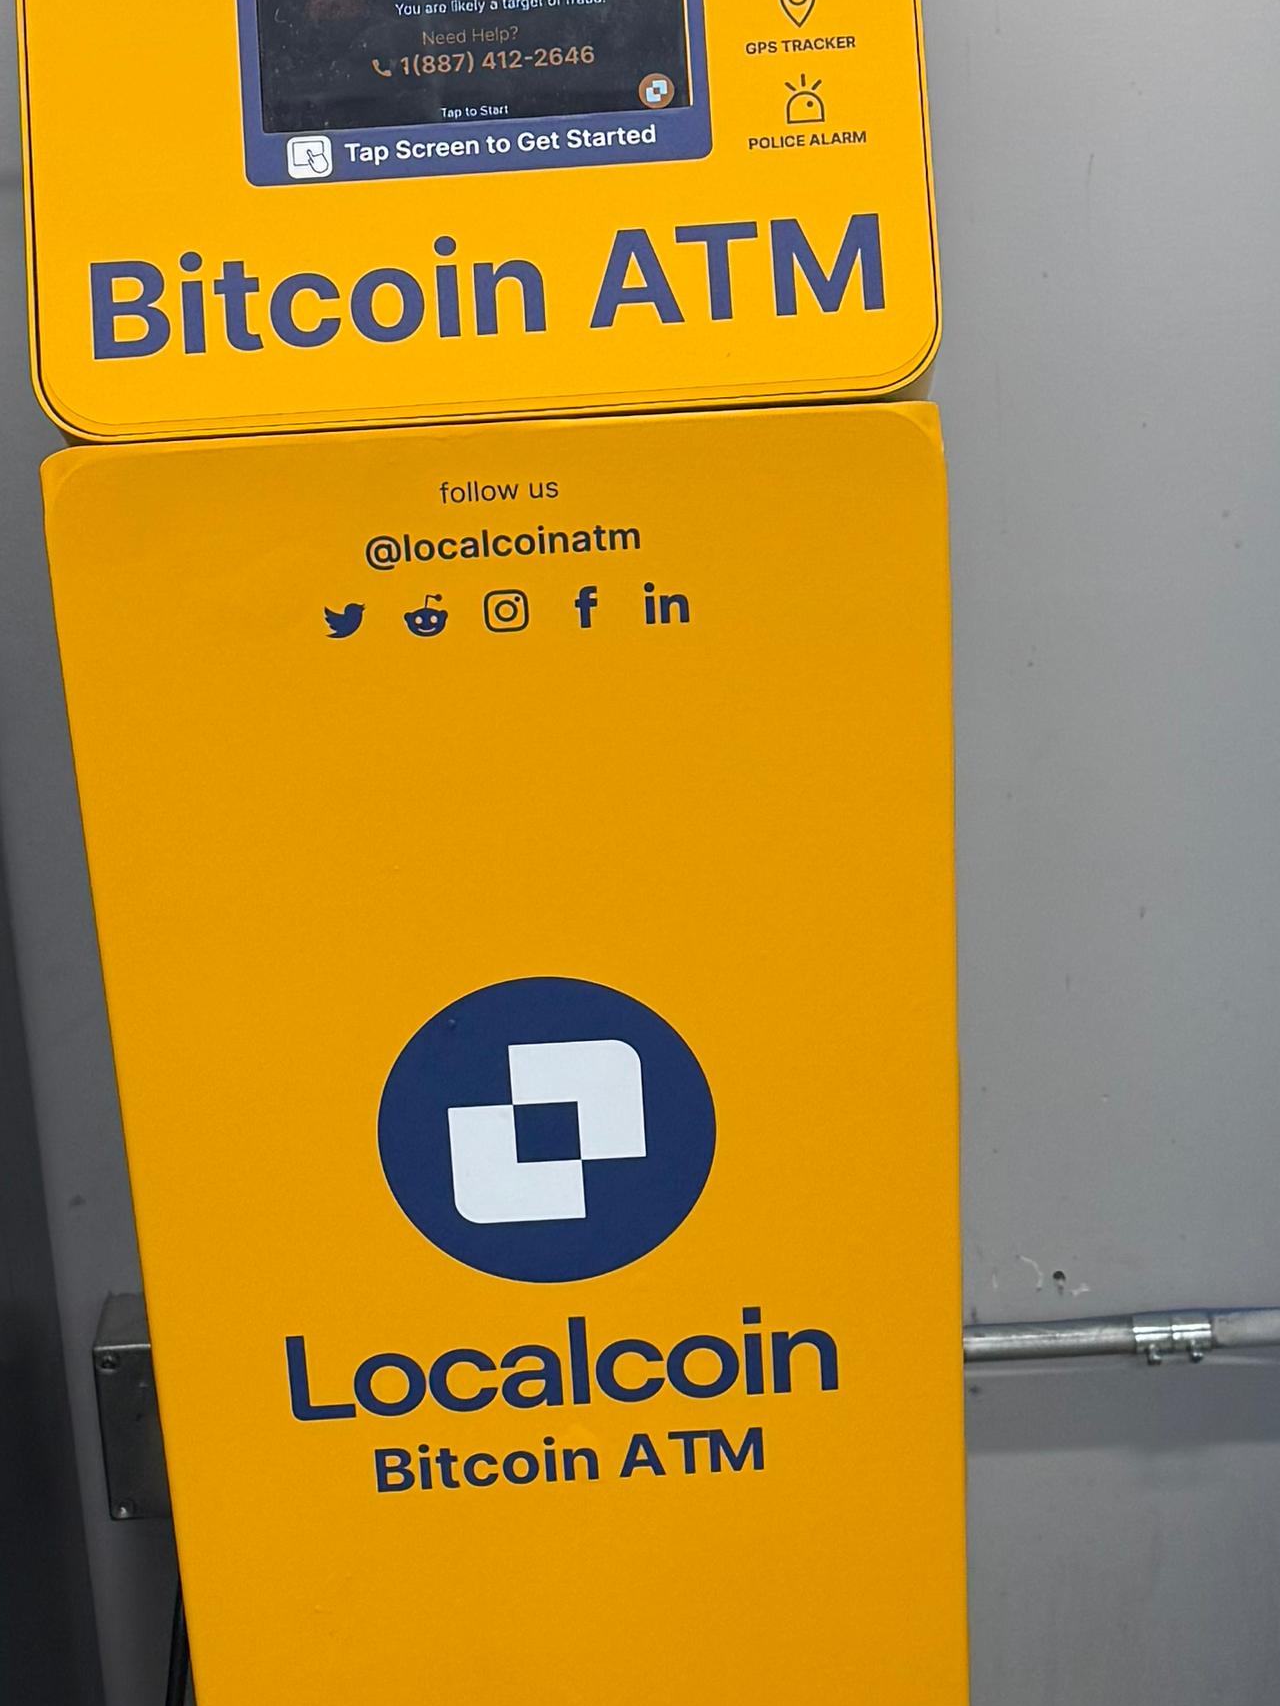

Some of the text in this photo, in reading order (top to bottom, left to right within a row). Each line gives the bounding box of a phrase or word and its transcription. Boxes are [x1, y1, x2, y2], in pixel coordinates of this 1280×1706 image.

[422, 26, 519, 45] Need Help?
[746, 36, 855, 55] GPS TRACKER
[400, 45, 594, 76] 1(887) 412-2646
[440, 104, 508, 119] Tap to Start
[344, 124, 656, 165] Tap Screen to Get Started
[749, 131, 867, 150] POLICE ALARM
[89, 212, 887, 361] Bitcoin ATM
[440, 481, 559, 504] follow us
[366, 526, 640, 571] @localcoinatm
[644, 582, 690, 625] in
[285, 1307, 839, 1422] Localcoin
[374, 1427, 766, 1494] Bitcoin ATM
